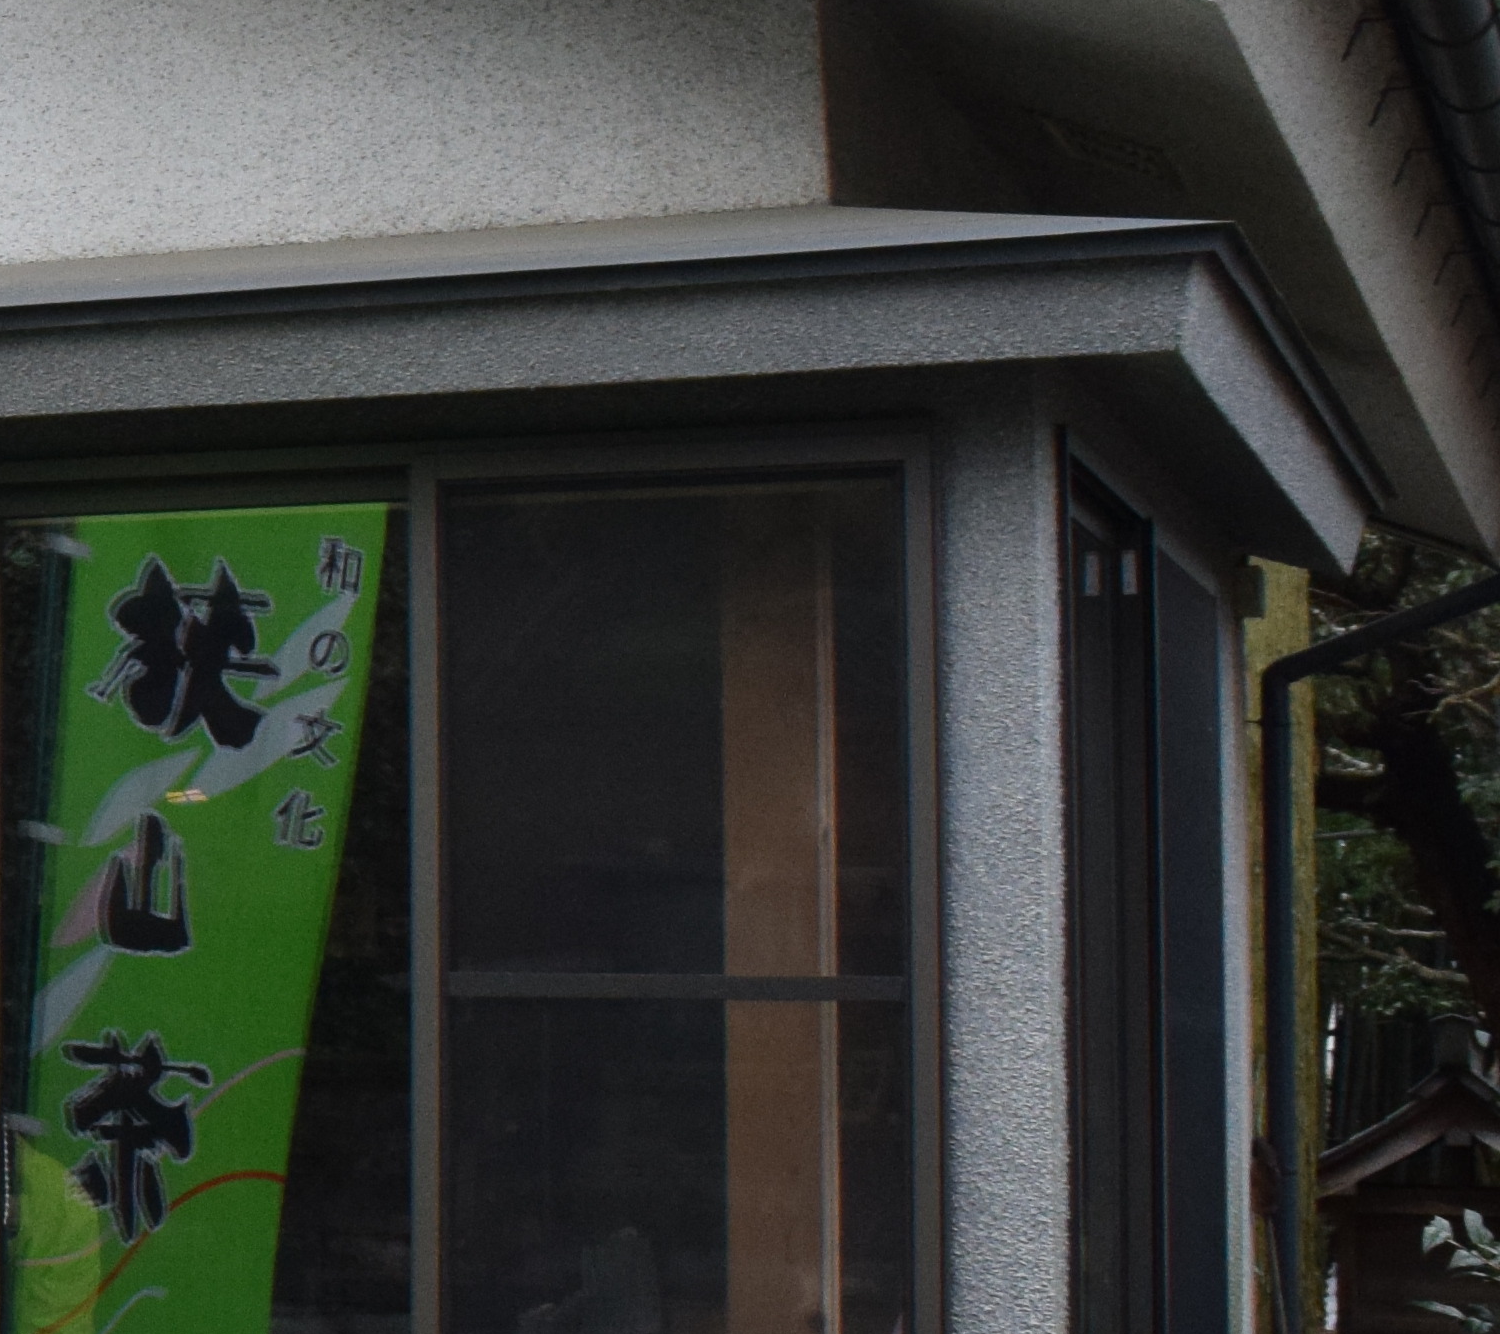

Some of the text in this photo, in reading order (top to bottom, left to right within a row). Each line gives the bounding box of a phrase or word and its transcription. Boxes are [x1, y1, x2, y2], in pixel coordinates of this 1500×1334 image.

[59, 550, 282, 1245] 狭山茶
[271, 531, 367, 854] 和の文化
